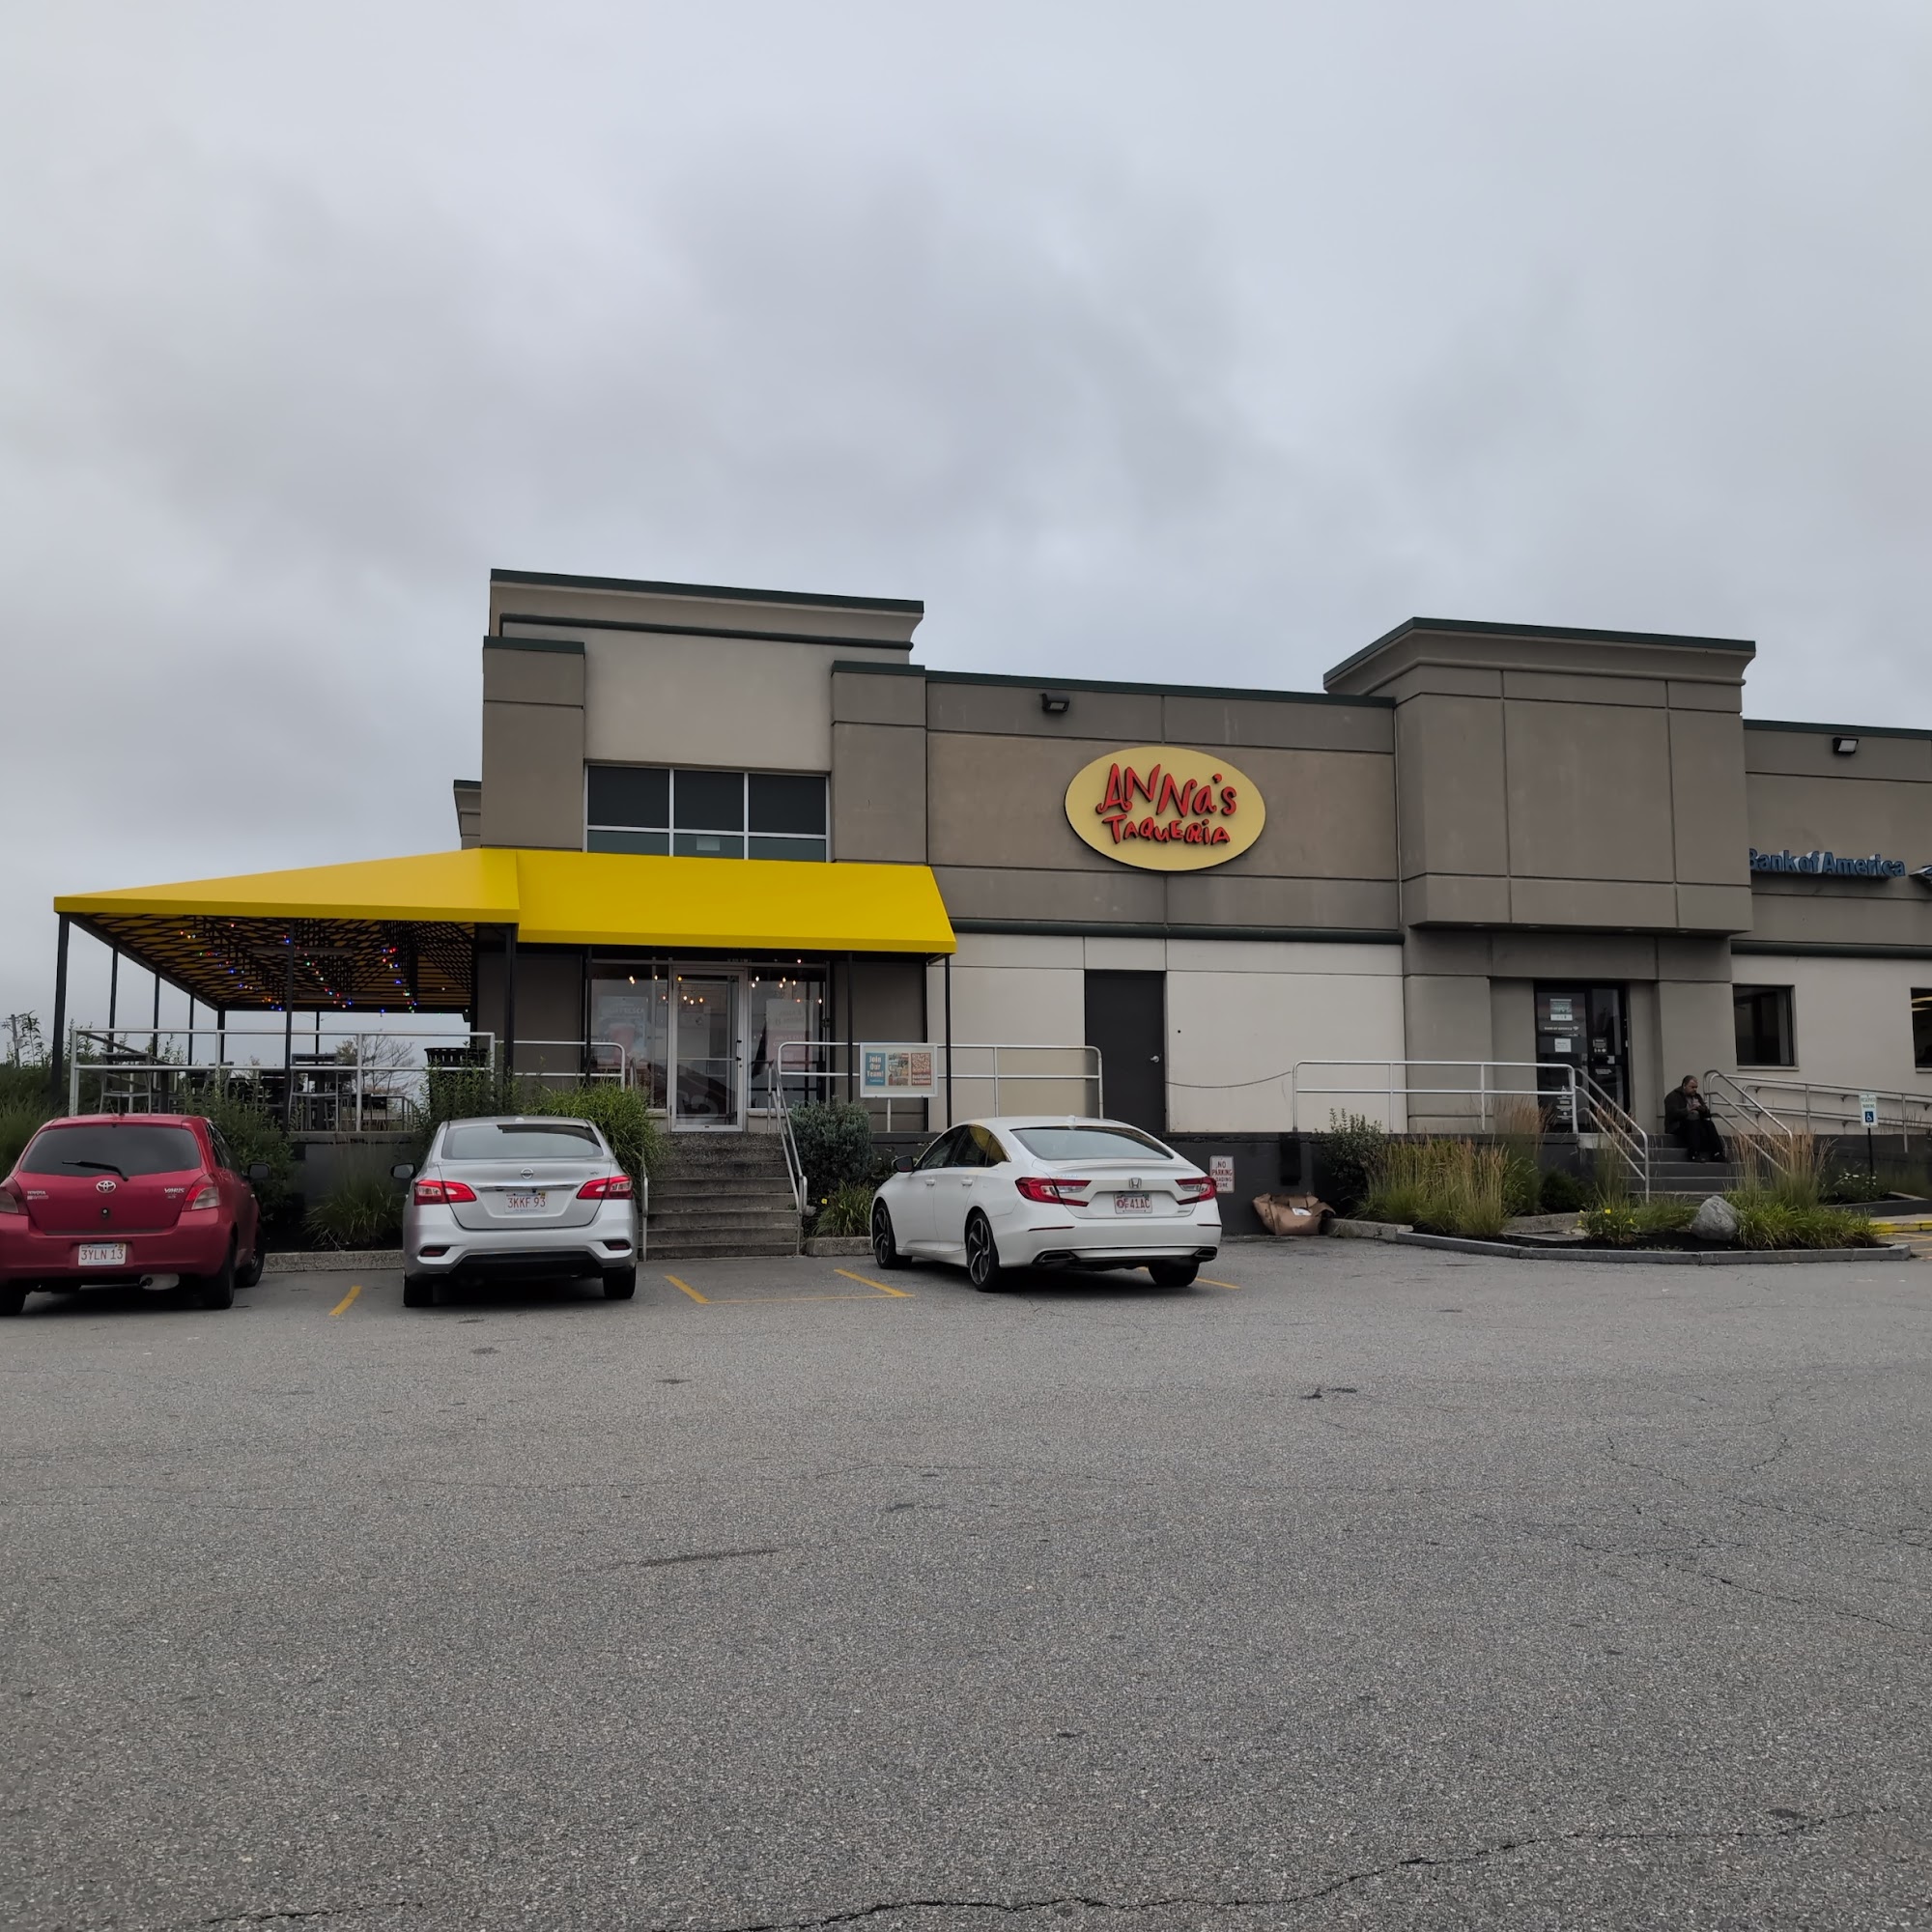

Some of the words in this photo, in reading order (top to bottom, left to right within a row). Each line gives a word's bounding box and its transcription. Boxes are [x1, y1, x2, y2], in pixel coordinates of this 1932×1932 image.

[1749, 847, 1797, 871] Bank
[1798, 850, 1820, 873] of
[1821, 851, 1906, 877] America
[1217, 1160, 1227, 1169] NO
[507, 1197, 531, 1208] 3KKF
[533, 1197, 546, 1208] 93
[1129, 1198, 1151, 1208] 41AC
[80, 1249, 107, 1261] 3YLN
[110, 1248, 124, 1261] 13
